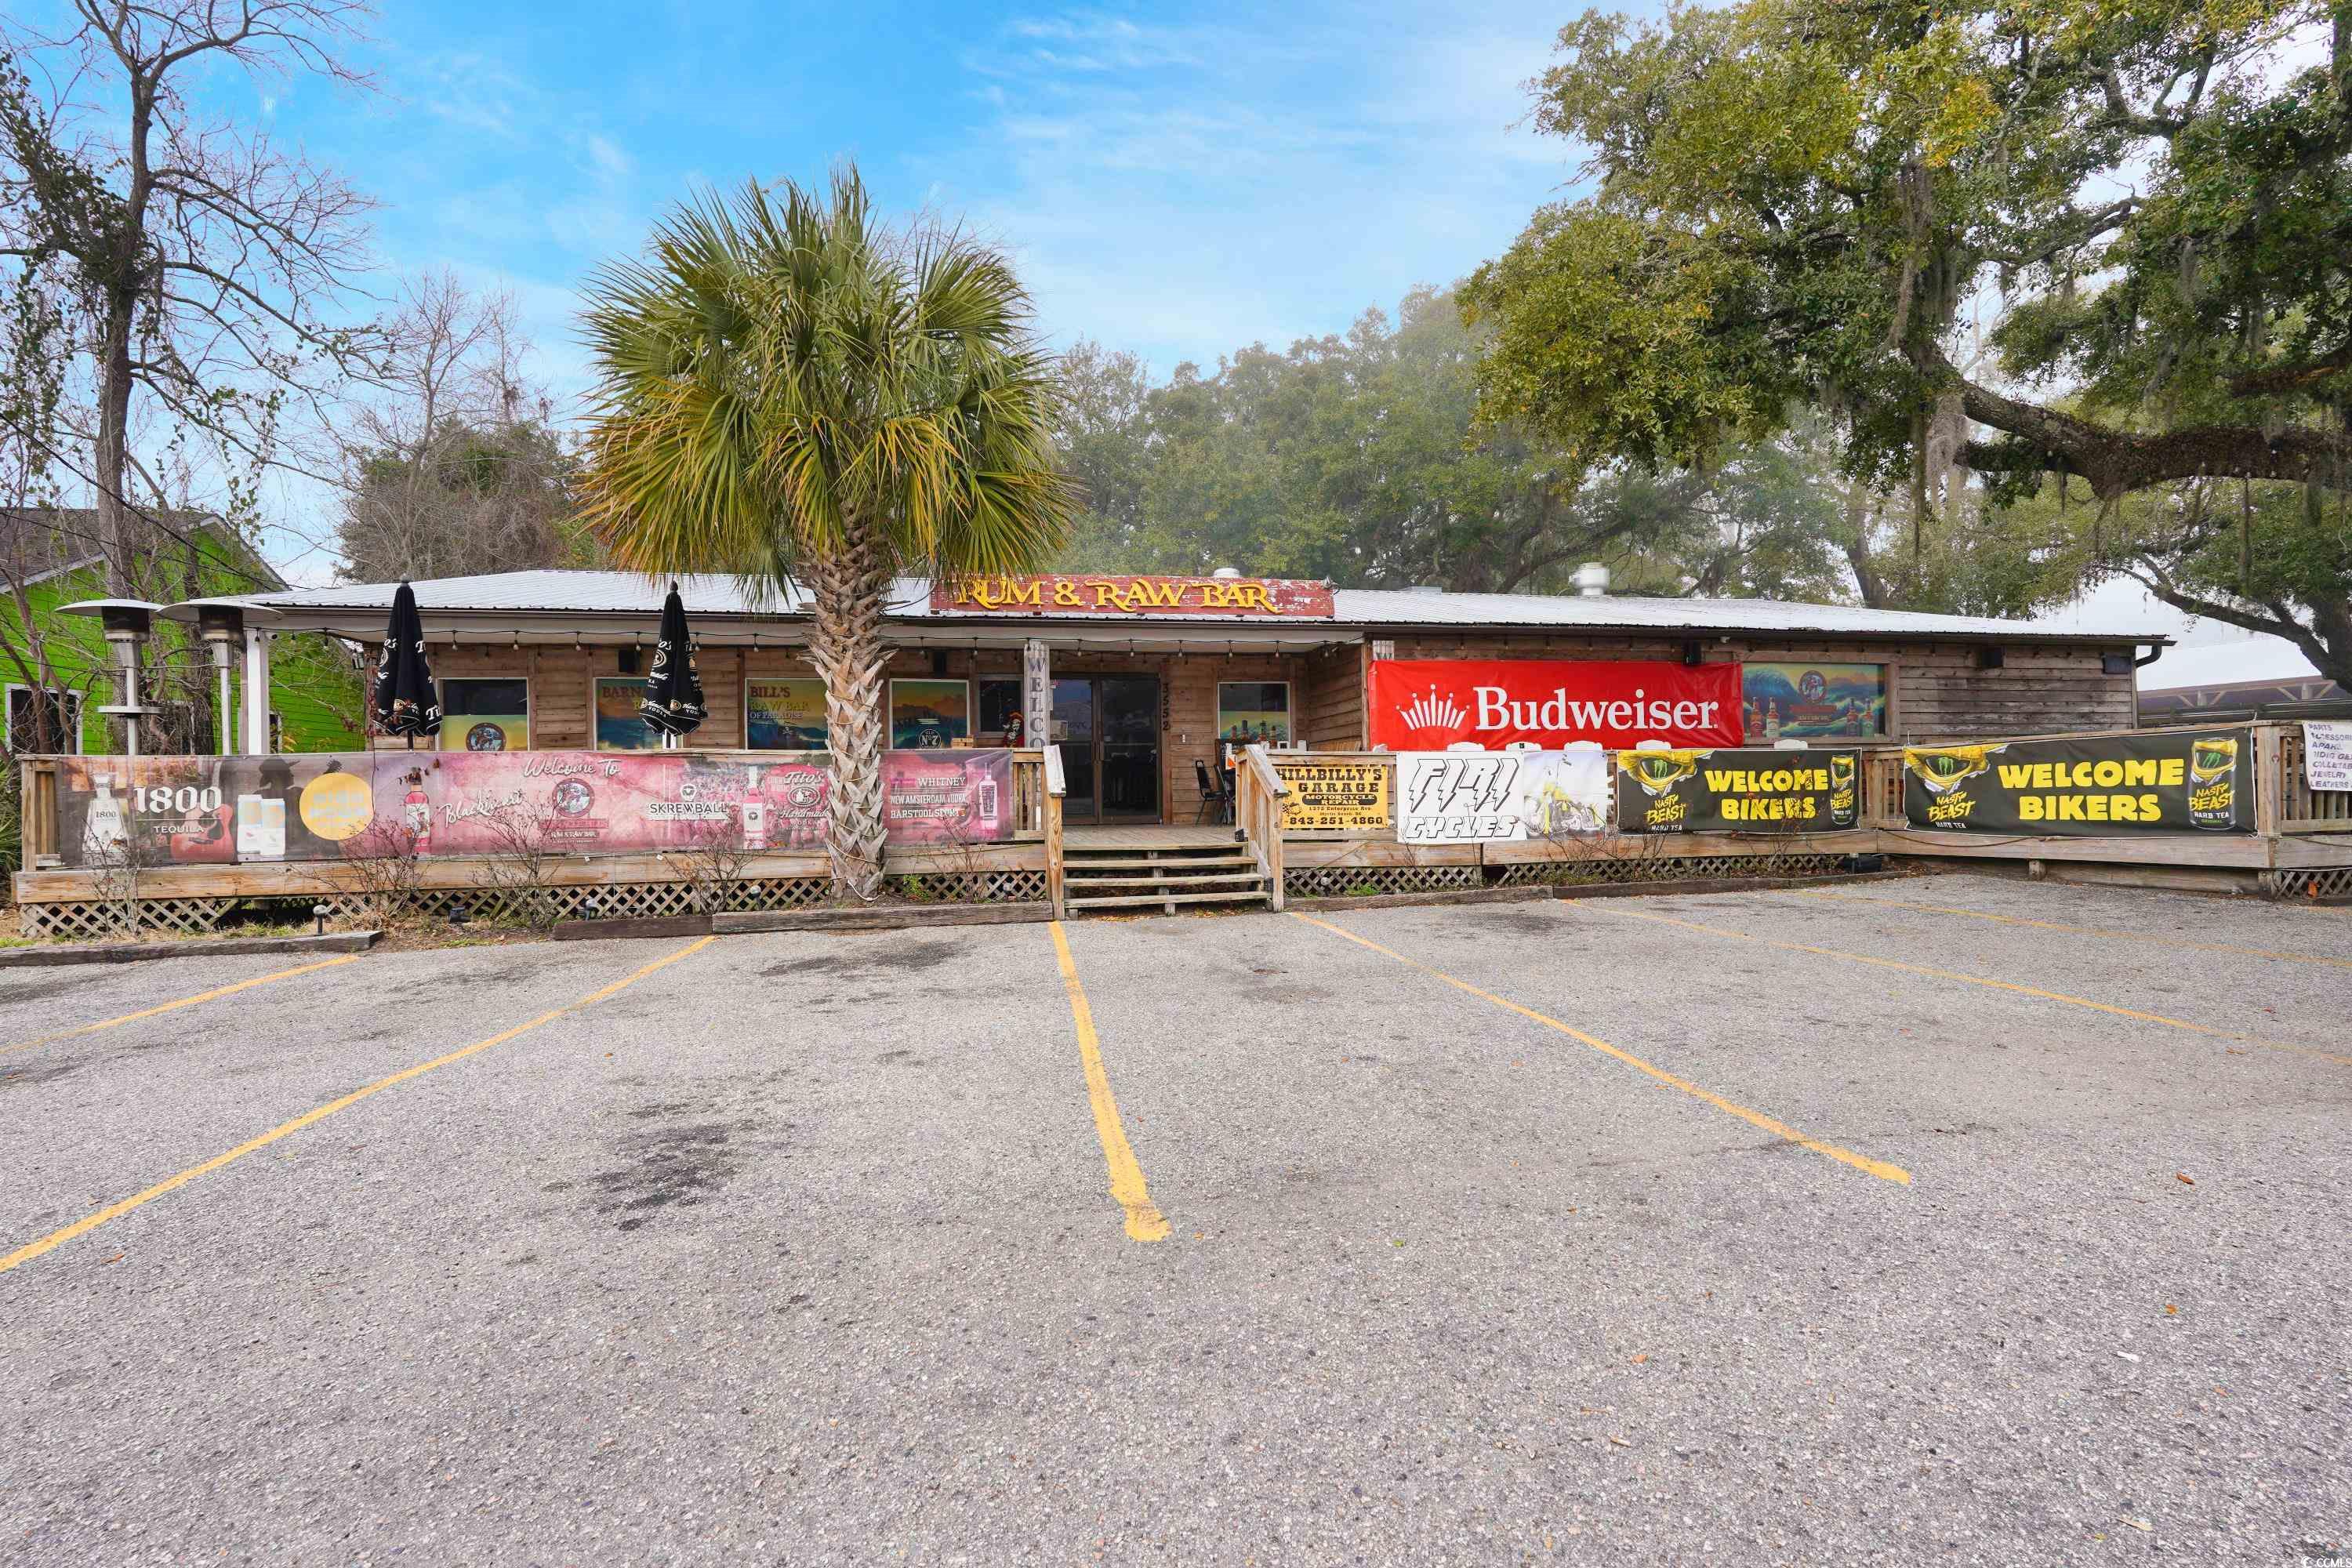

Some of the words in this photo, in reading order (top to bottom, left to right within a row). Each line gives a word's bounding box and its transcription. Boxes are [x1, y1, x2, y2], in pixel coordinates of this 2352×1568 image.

[956, 578, 1046, 609] RUM
[1054, 581, 1083, 607] &
[1084, 578, 1187, 612] RAW
[1191, 581, 1284, 615] BAR
[750, 686, 791, 698] BILL'S
[1472, 686, 1720, 731] Budweiser
[524, 757, 597, 777] Welcome
[597, 759, 622, 777] To
[1277, 768, 1382, 781] HILLBILLY'S
[1998, 758, 2184, 789] WELCOME
[784, 771, 824, 784] Tito's
[918, 777, 966, 787] WHITNEY
[1704, 769, 1828, 793] WELCOME
[1298, 782, 1379, 793] GARAGE
[1835, 789, 1852, 800] NASTY
[2196, 782, 2229, 798] NASTY
[134, 786, 222, 813] 1800
[891, 794, 905, 805] NEW
[906, 793, 946, 805] AMSTERDAM
[947, 793, 967, 804] VODKA
[1654, 794, 1679, 810] NASTY
[1936, 791, 1968, 805] NASTY
[2188, 789, 2236, 811] BEAST
[649, 803, 728, 814] SKREWBALL
[779, 808, 829, 818] Handmad
[891, 809, 933, 819] BARSTOOL
[1645, 804, 1686, 825] BEAST
[1721, 797, 1817, 821] BIKERS
[1927, 801, 1976, 822] BEAST
[2019, 794, 2161, 822] BIKERS
[154, 826, 205, 834] TEQUILA
[1404, 815, 1518, 839] CYCLES
